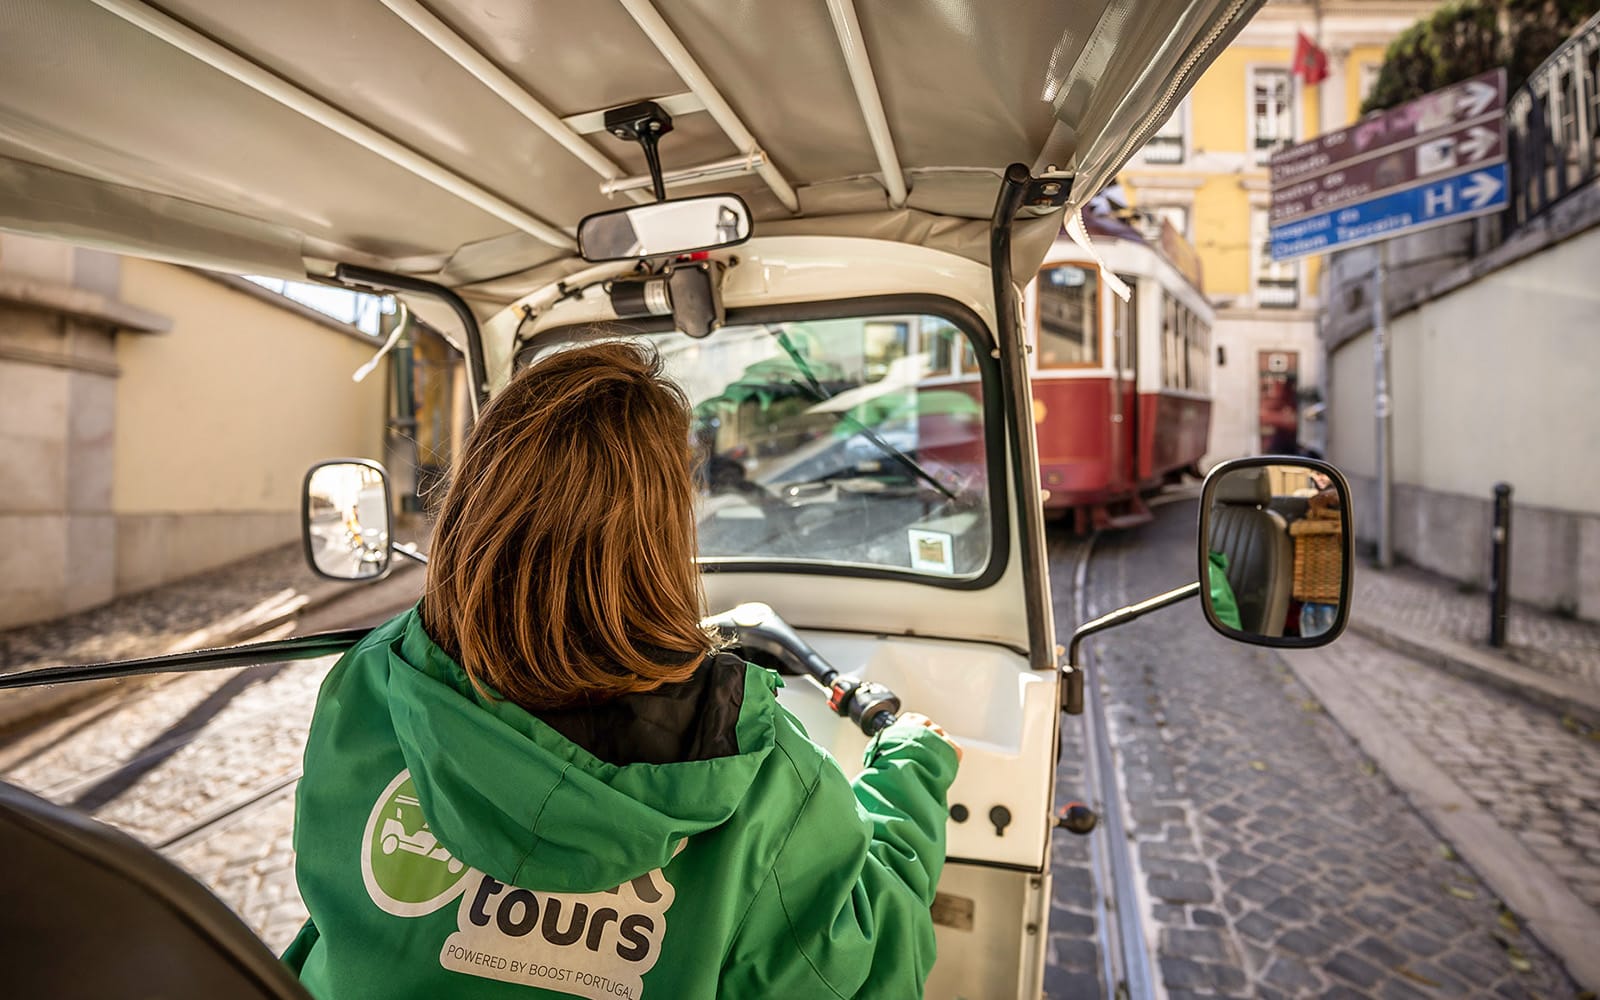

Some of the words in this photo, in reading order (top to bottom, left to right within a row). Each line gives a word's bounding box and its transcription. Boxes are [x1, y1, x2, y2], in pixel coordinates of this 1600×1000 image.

[1424, 183, 1454, 218] H
[469, 874, 655, 962] tours
[446, 944, 508, 970] POWERED
[510, 960, 529, 973] BY
[528, 964, 574, 982] BOOST
[575, 971, 634, 1000] PORTUGAL
